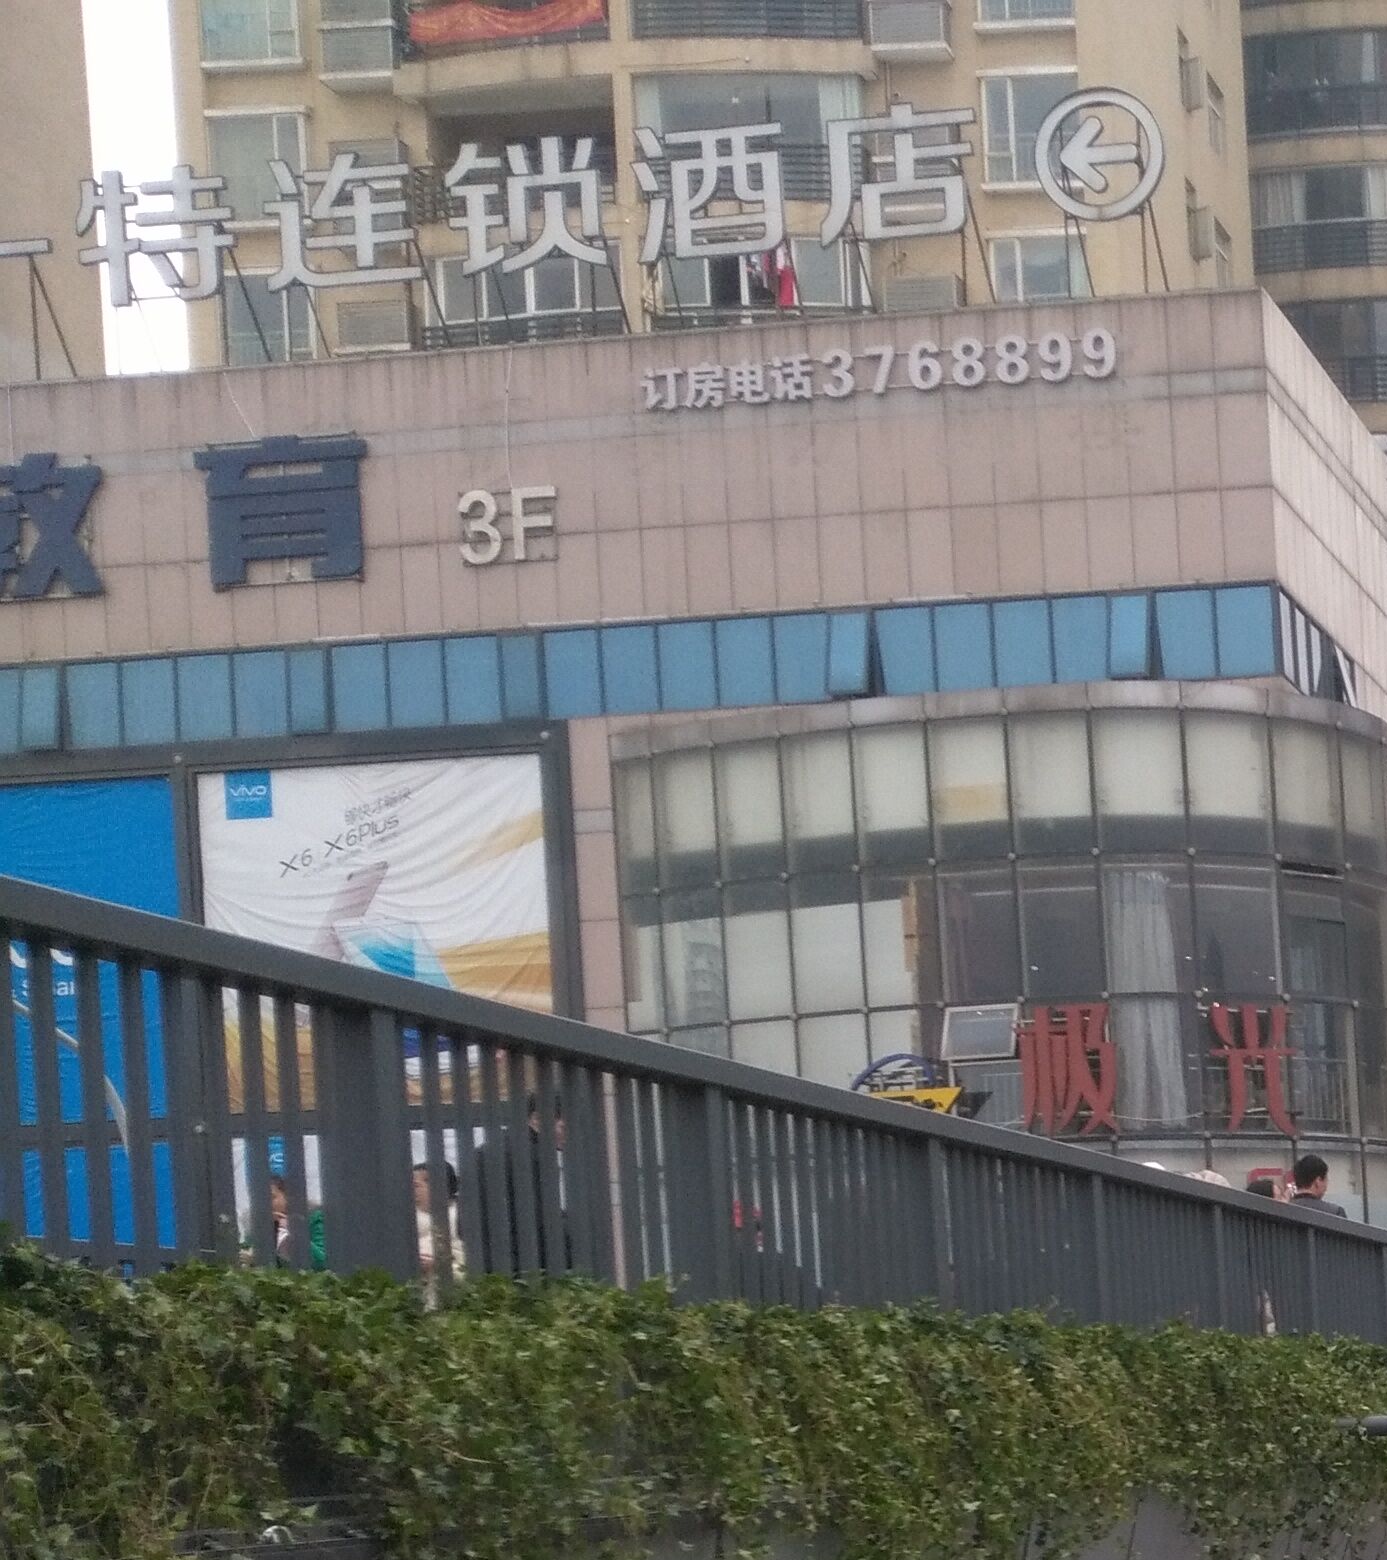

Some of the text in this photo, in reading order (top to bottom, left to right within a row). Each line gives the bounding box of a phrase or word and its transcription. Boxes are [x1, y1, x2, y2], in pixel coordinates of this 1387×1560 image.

[0, 103, 978, 307] 特连锁酒店
[458, 485, 559, 568] 3F
[229, 784, 268, 798] vivo
[279, 848, 313, 878] X6
